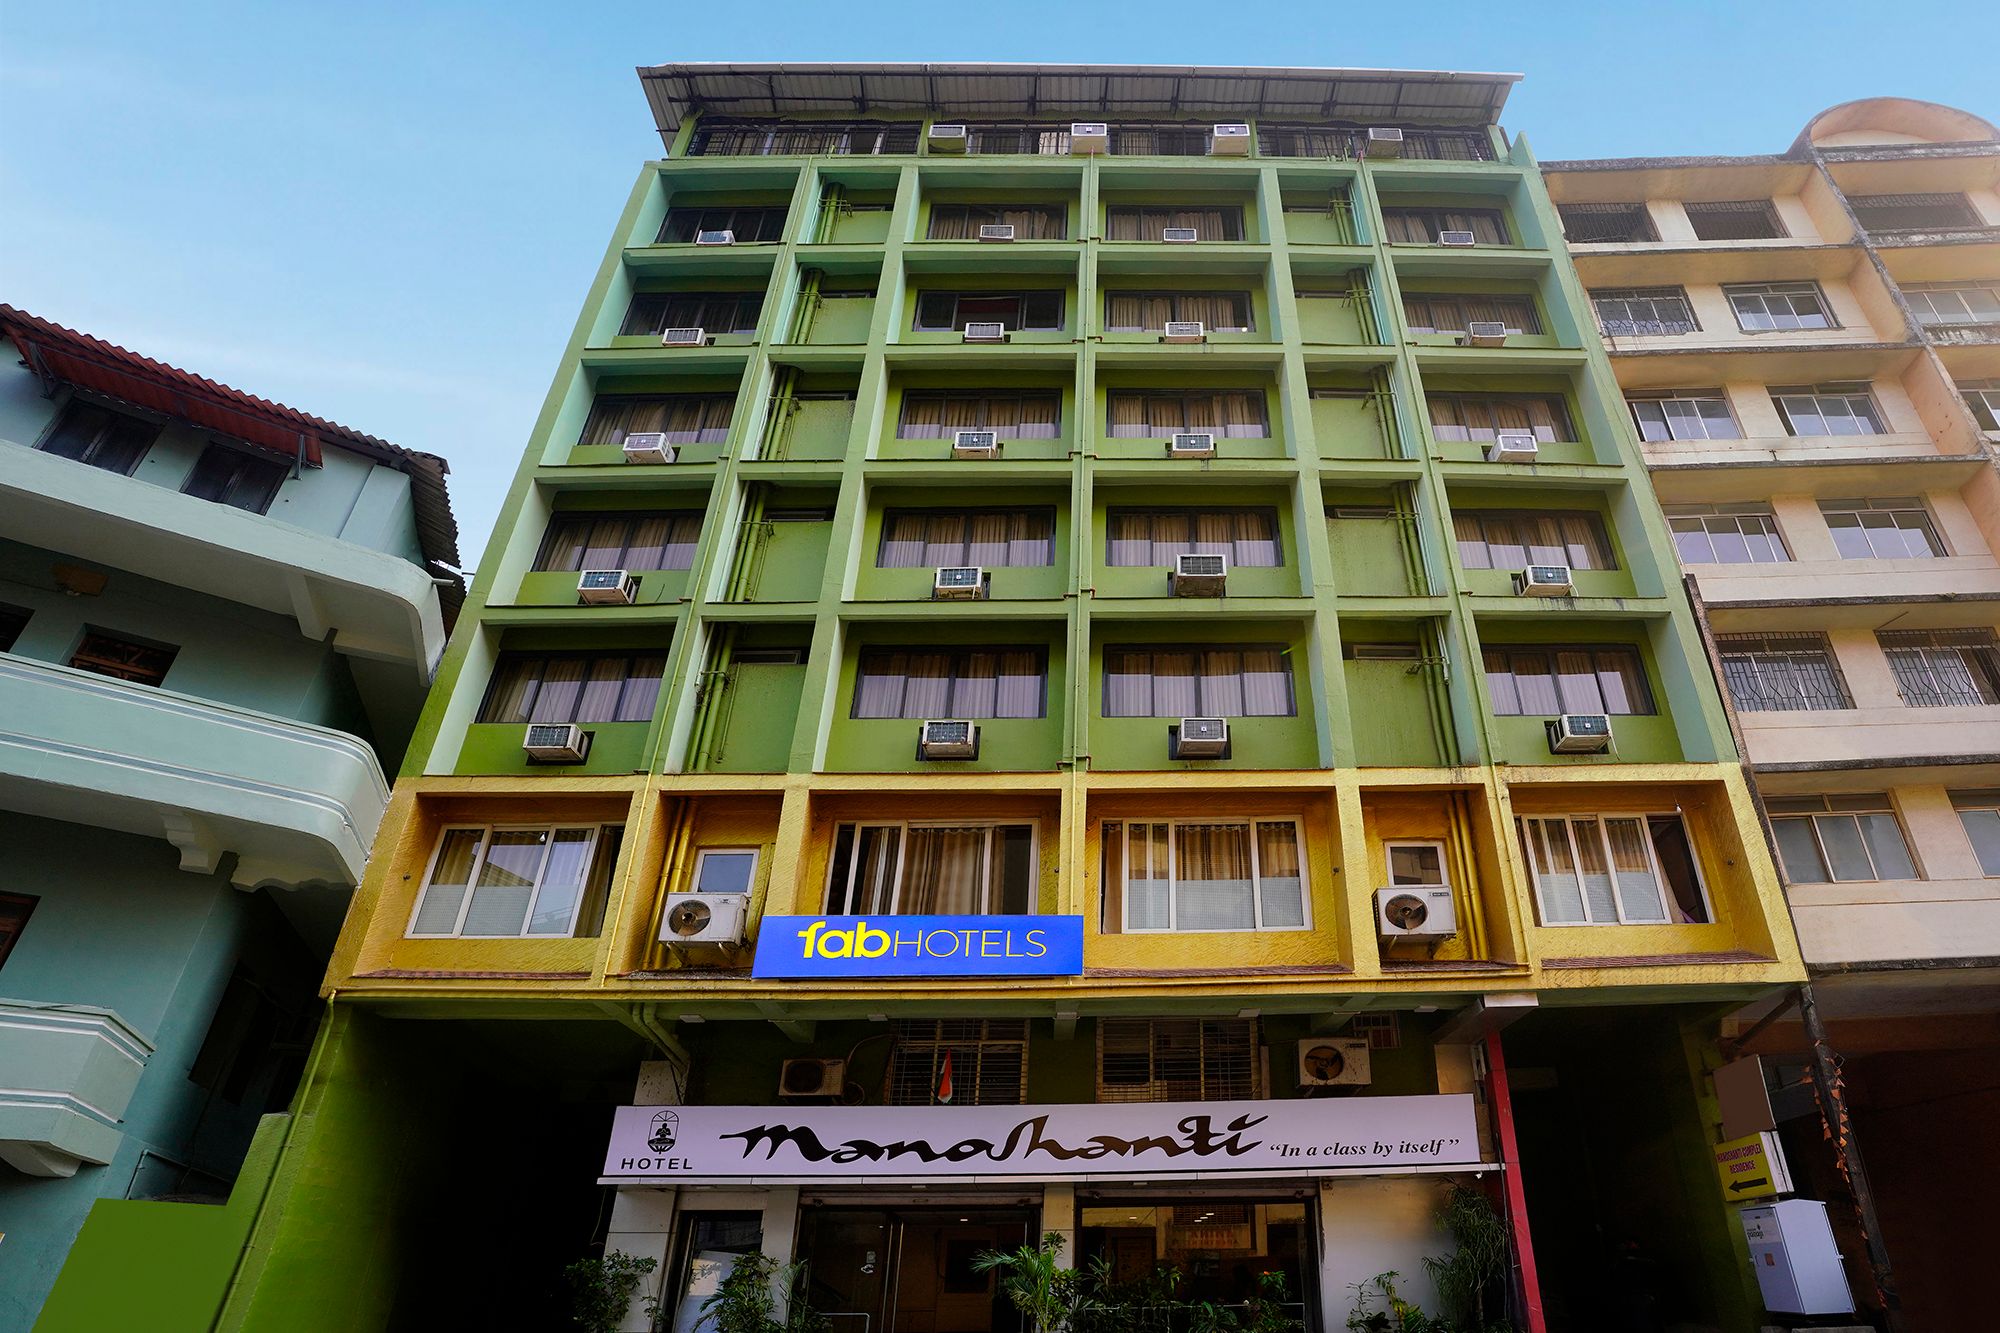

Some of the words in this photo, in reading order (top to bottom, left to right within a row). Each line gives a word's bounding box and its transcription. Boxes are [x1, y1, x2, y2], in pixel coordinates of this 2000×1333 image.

[1306, 1145, 1318, 1157] a
[1323, 1142, 1367, 1156] class
[1372, 1141, 1393, 1157] by
[620, 1157, 693, 1170] HOTEL
